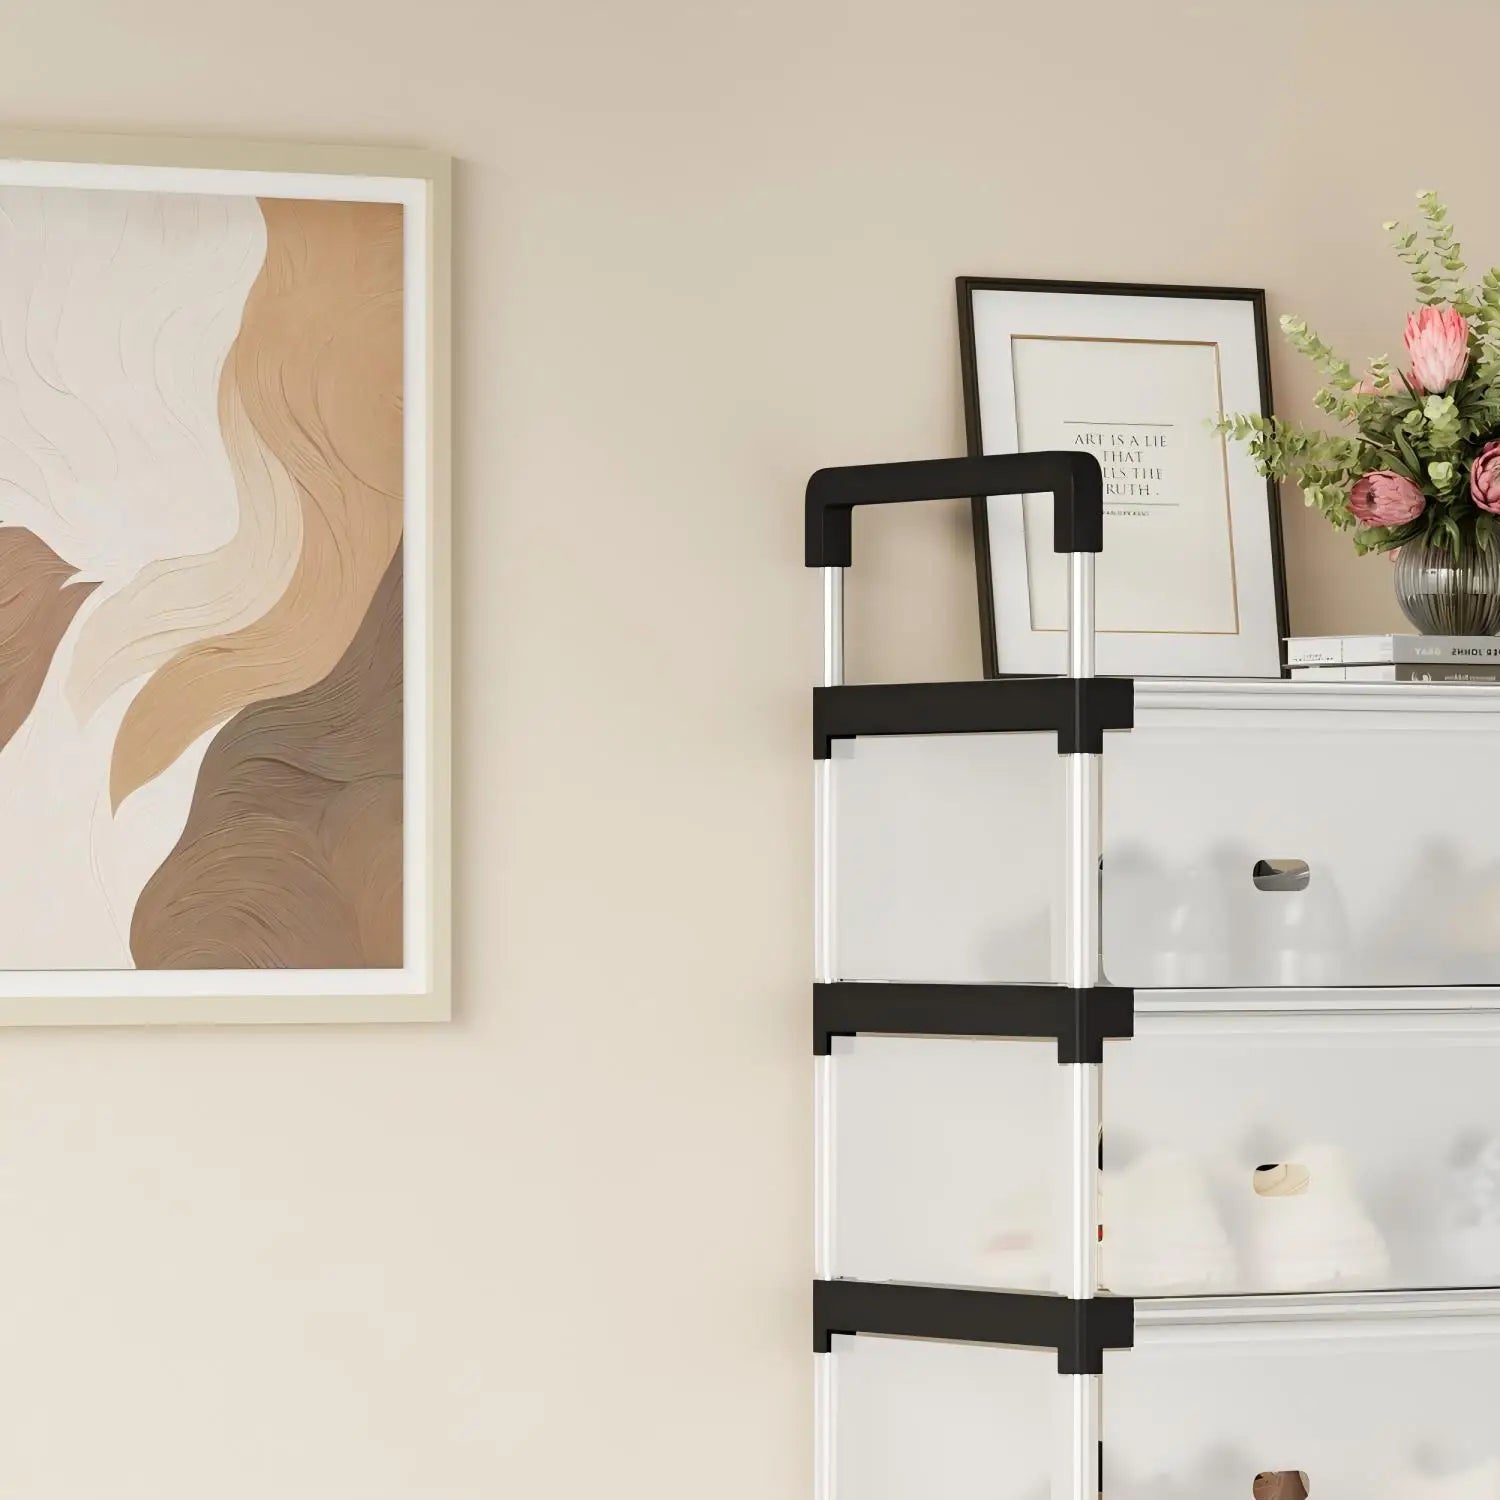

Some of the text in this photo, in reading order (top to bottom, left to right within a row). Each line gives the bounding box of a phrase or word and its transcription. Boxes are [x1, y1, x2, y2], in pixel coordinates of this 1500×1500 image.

[1075, 434, 1168, 447] ART IS A LIE
[1103, 451, 1144, 463] THAT
[1103, 467, 1164, 480] LLS THE
[1105, 483, 1160, 496] RUTH.
